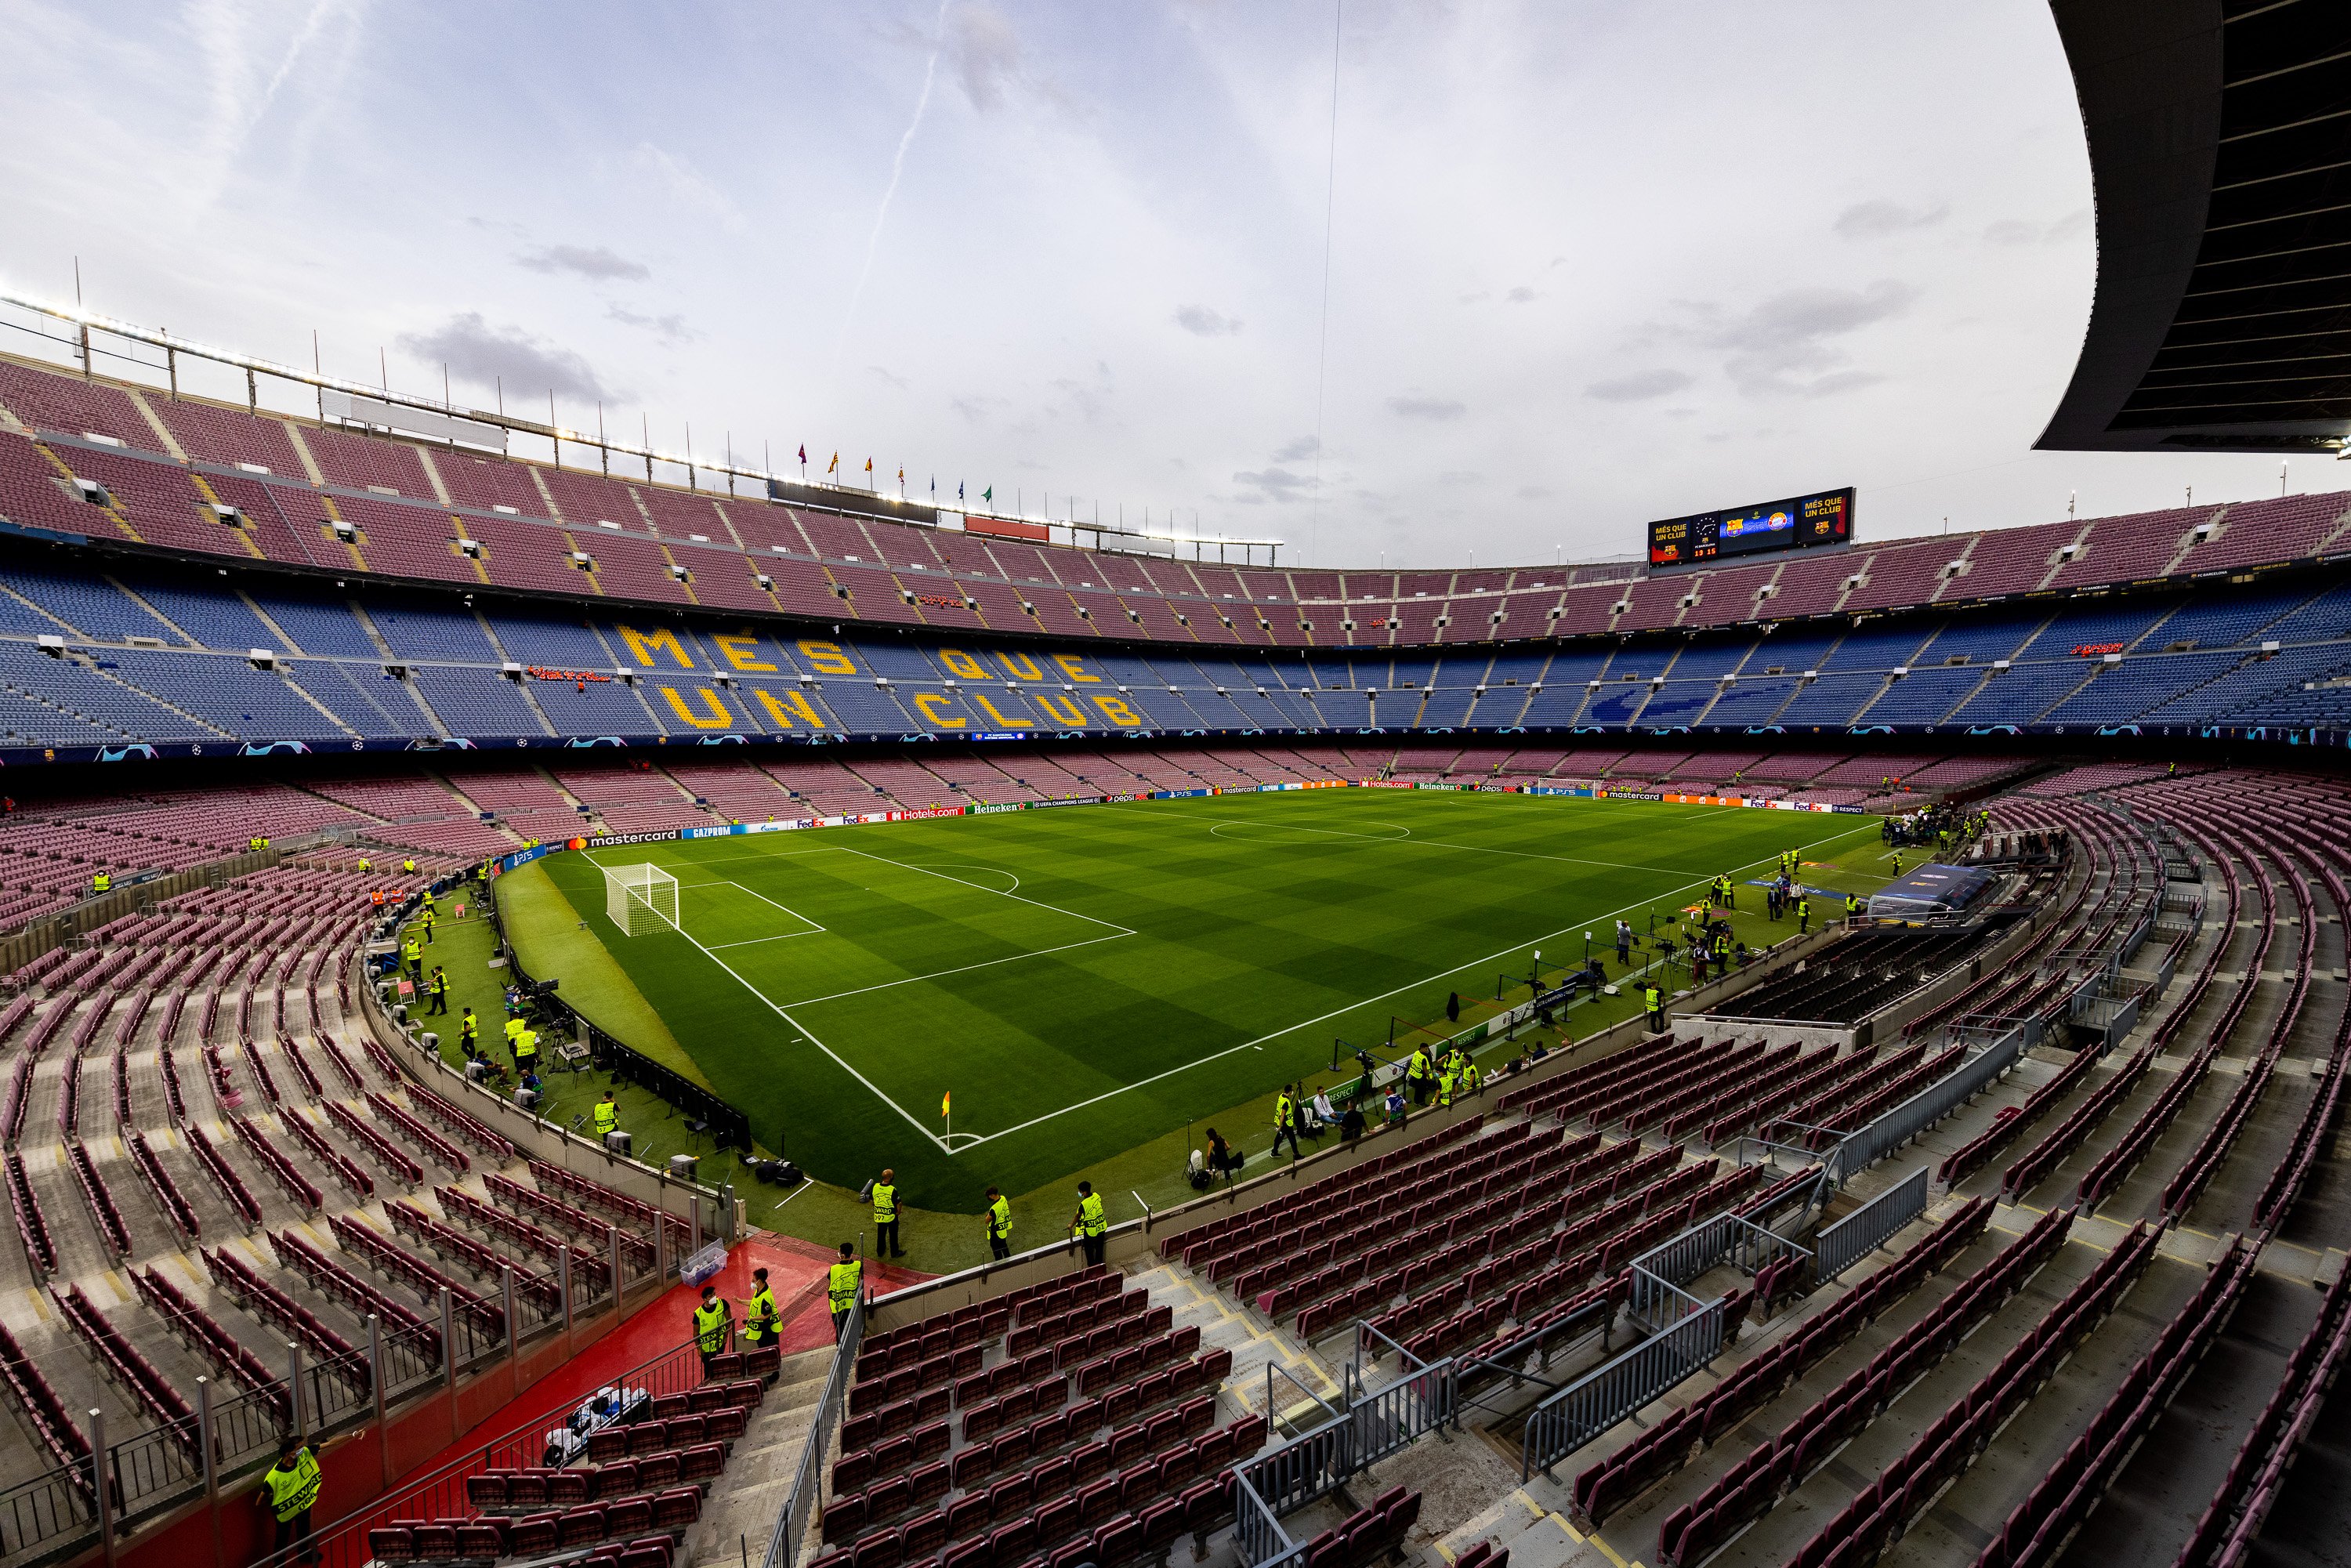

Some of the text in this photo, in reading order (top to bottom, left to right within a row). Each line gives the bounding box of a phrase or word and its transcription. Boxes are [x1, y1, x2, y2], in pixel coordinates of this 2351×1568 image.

[1805, 497, 1842, 509] MÉS QUE
[1806, 505, 1841, 517] UN CLUB
[1656, 523, 1686, 534] MÉS QUE
[617, 623, 1101, 682] MÉS QUE
[660, 686, 1141, 728] UN CLUB
[1223, 785, 1256, 794] mastercard
[1419, 781, 1454, 790] Heineken
[1114, 794, 1134, 802] pepsi
[1610, 791, 1660, 800] mastercard
[974, 803, 1017, 813] Heineken
[1751, 799, 1777, 809] FedEx
[1794, 802, 1822, 812] FedEx
[843, 815, 868, 824] FedEx
[904, 809, 958, 820] Hotels.com
[797, 818, 824, 828] FedEx
[694, 826, 731, 838] GAZPROM
[591, 830, 676, 846] mastercard
[519, 850, 533, 863] PS5
[1458, 1033, 1476, 1045] RESPECT
[1330, 1086, 1353, 1102] RESPECT
[278, 1473, 321, 1512] STEWARD
